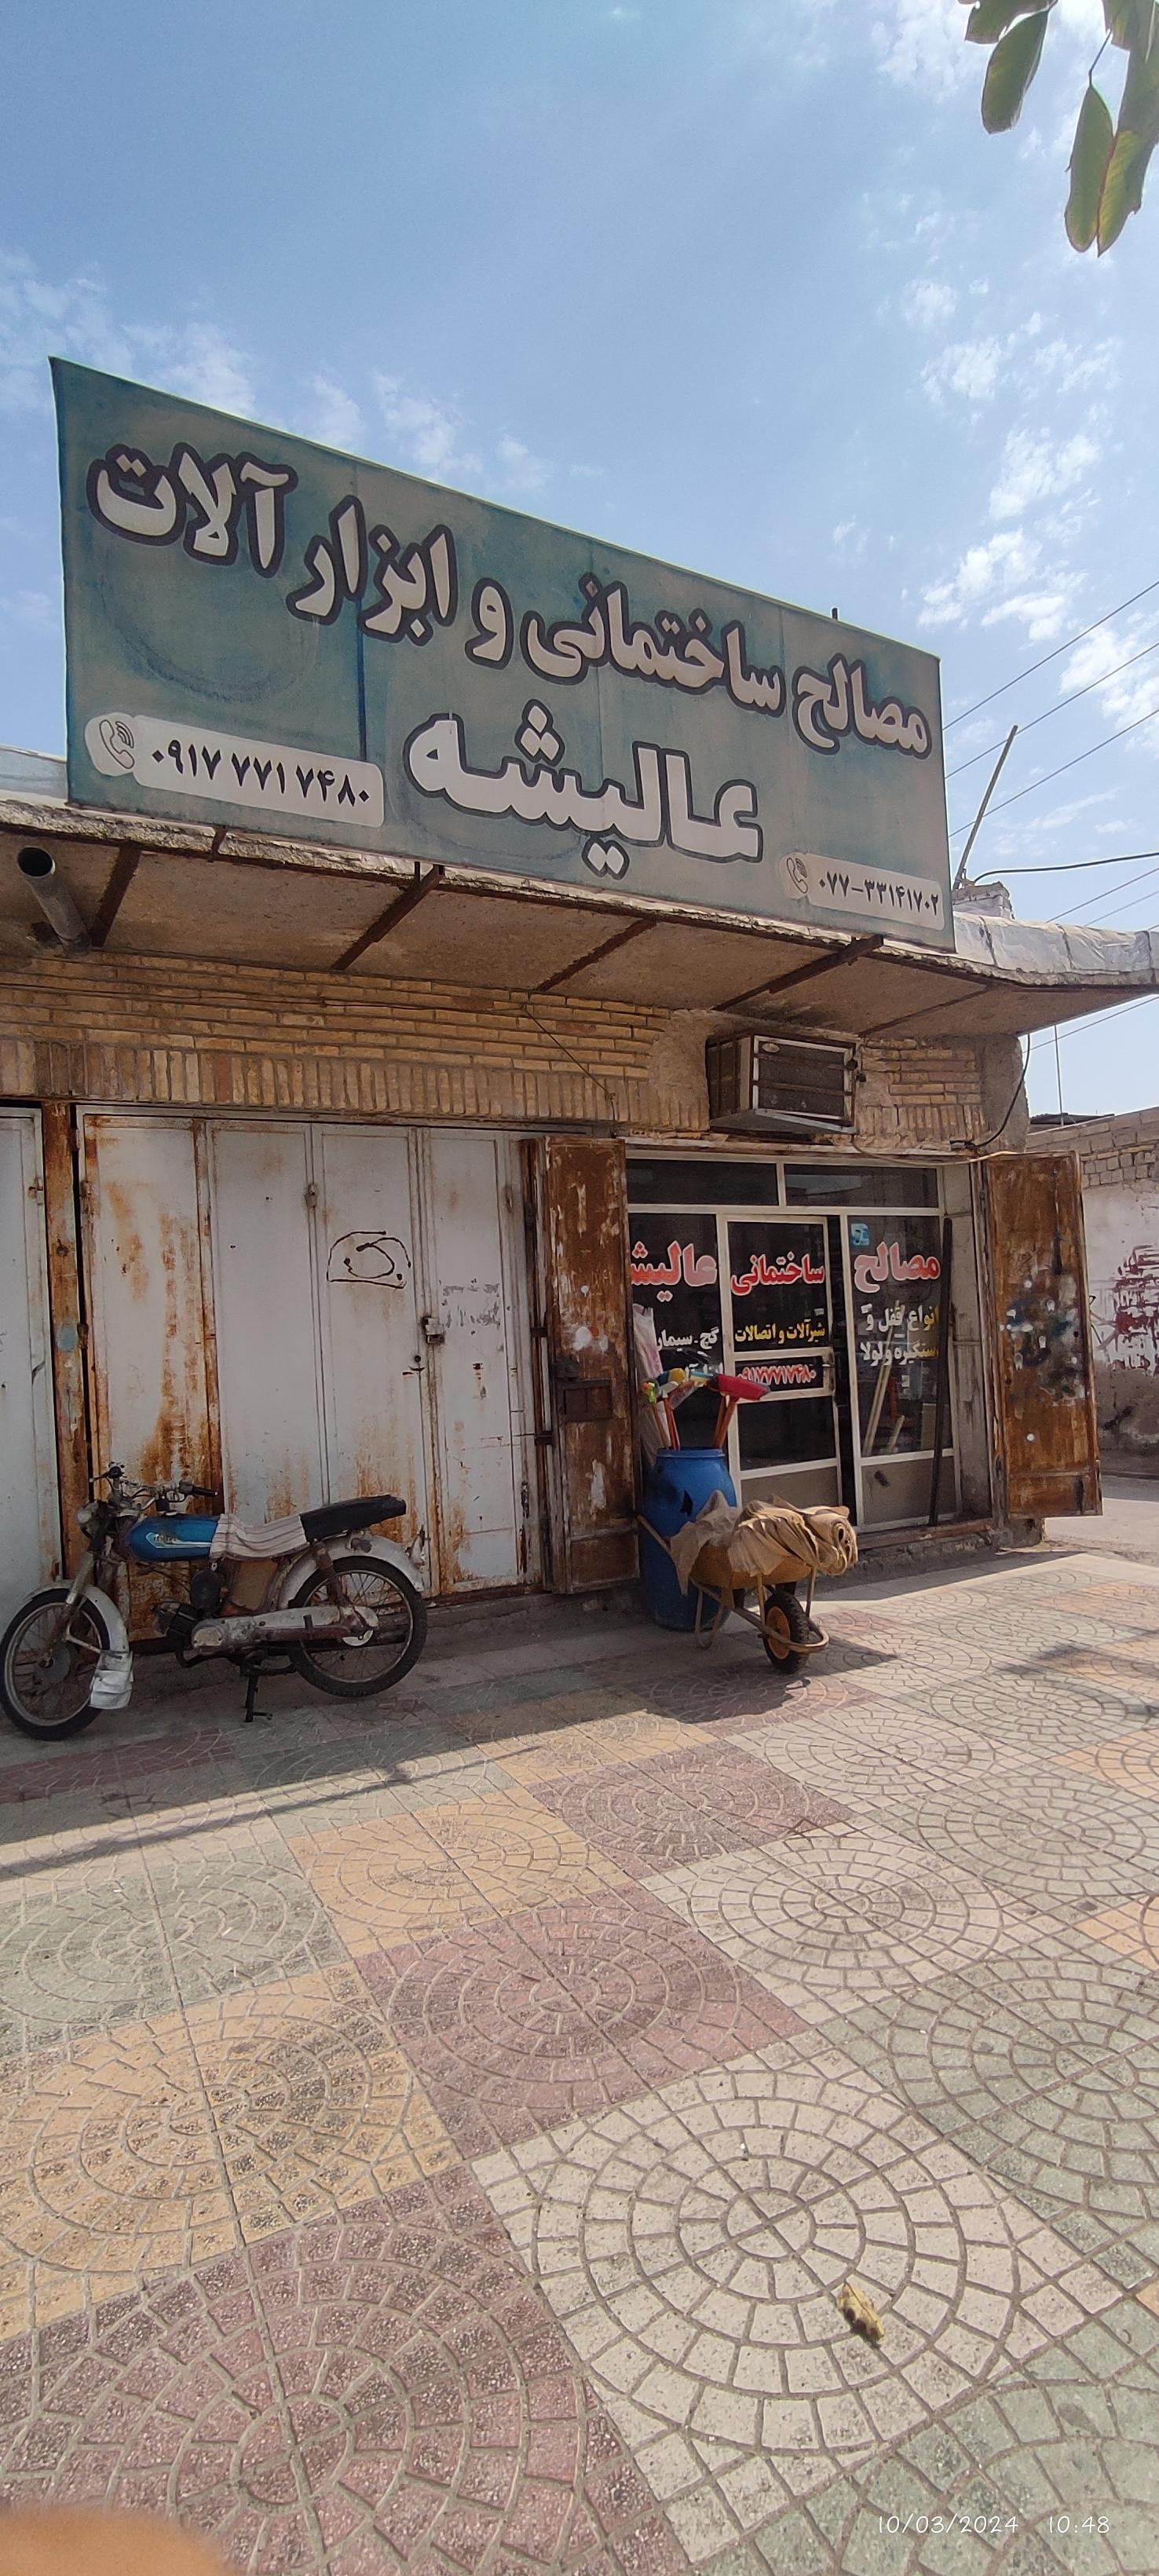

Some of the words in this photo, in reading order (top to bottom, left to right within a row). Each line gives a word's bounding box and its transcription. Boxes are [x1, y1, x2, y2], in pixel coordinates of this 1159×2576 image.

[87, 445, 297, 576] آلات
[287, 496, 456, 644] ابزار
[466, 579, 511, 667] و
[522, 573, 784, 717] ساختمانی
[792, 653, 930, 759] مصالح
[152, 740, 221, 780] ۰۹۱۷
[232, 752, 285, 794] ۷۷۱
[296, 765, 370, 807] ۷۴۸۰
[404, 699, 762, 878] عالیشه
[631, 1240, 718, 1302] عالیش
[730, 1251, 825, 1295] ساختمانی
[854, 1242, 941, 1293] مصالح
[700, 1326, 719, 1349] گچ
[735, 1323, 776, 1341] اتصالات
[778, 1330, 784, 1344] و
[865, 1313, 874, 1331] و
[878, 1306, 905, 1332] قفل
[908, 1304, 939, 1331] انواع
[861, 1341, 883, 1367] لولا
[883, 1348, 892, 1366] و
